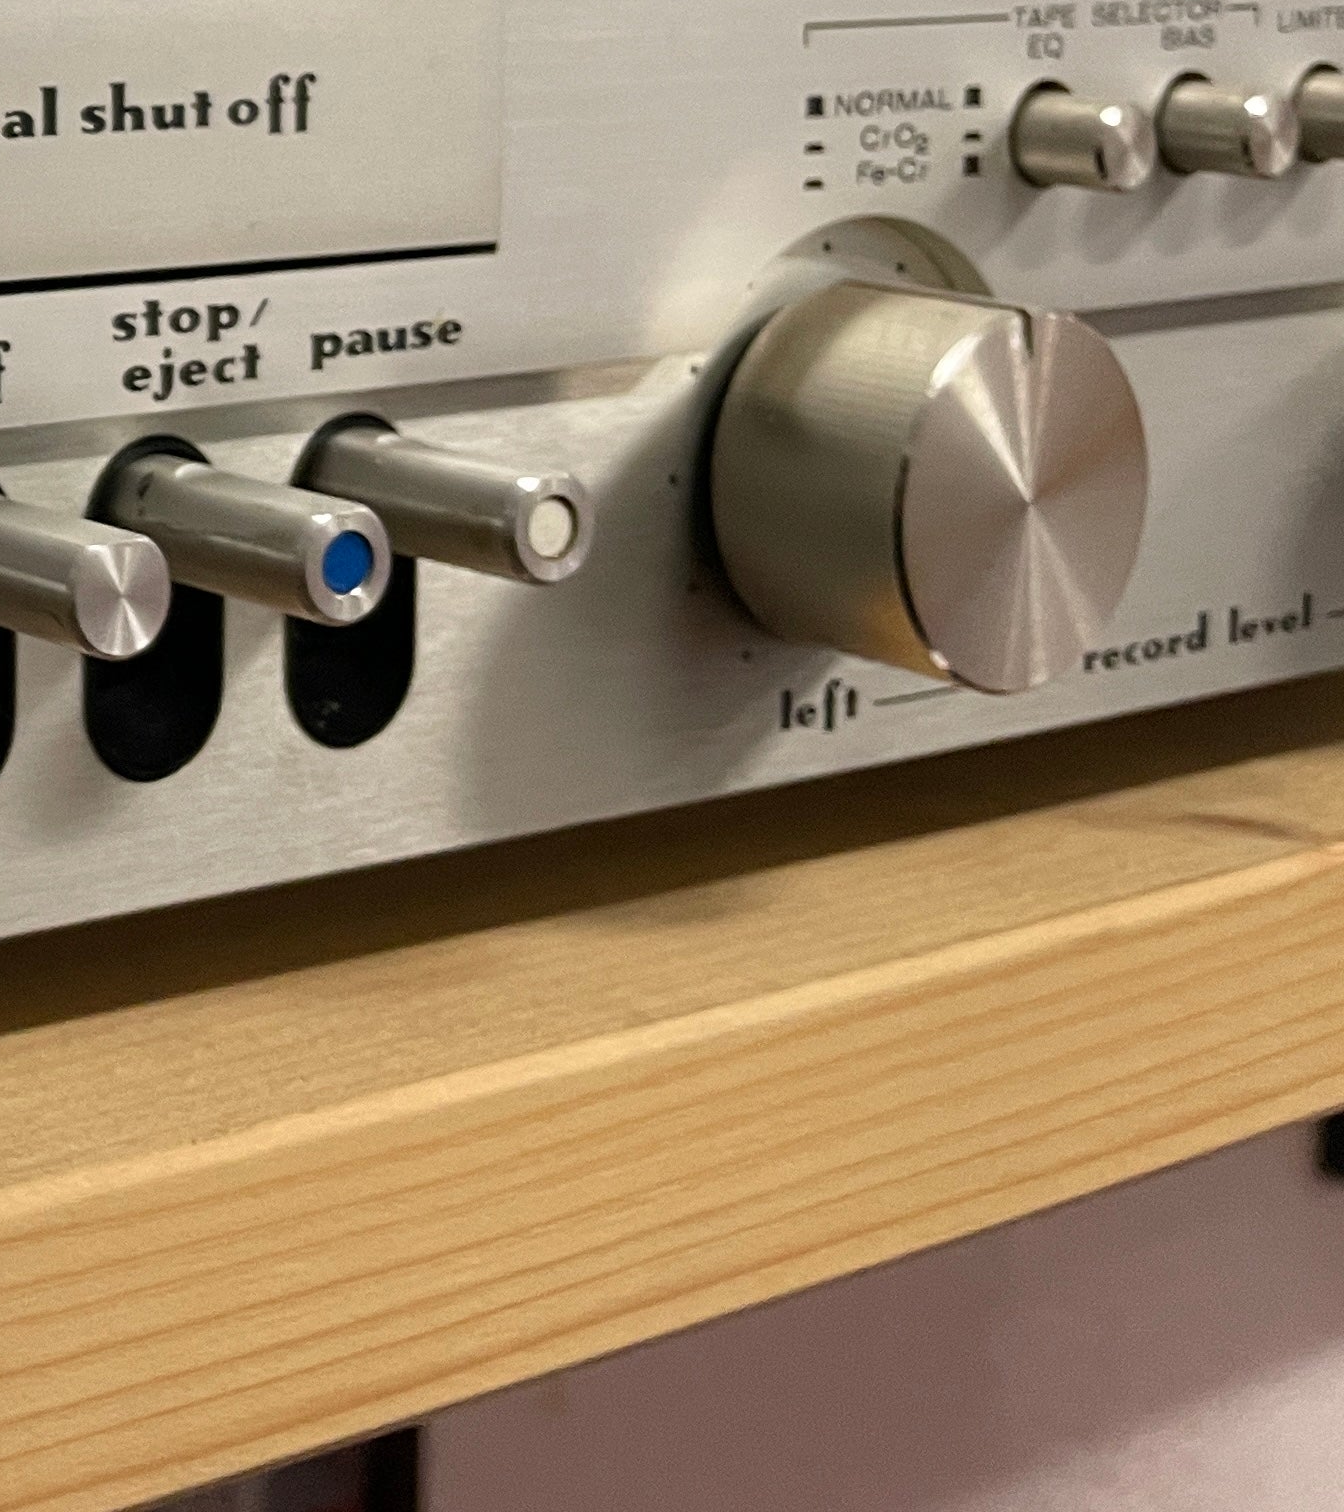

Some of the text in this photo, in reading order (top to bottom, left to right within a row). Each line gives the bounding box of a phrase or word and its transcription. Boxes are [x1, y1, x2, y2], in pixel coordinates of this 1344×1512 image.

[1014, 2, 1076, 30] TAPE
[833, 88, 953, 118] NORMAL
[110, 298, 269, 344] stop/
[310, 317, 462, 371] pause
[121, 345, 261, 400] eject
[1082, 591, 1313, 674] record level
[778, 678, 858, 732] left
